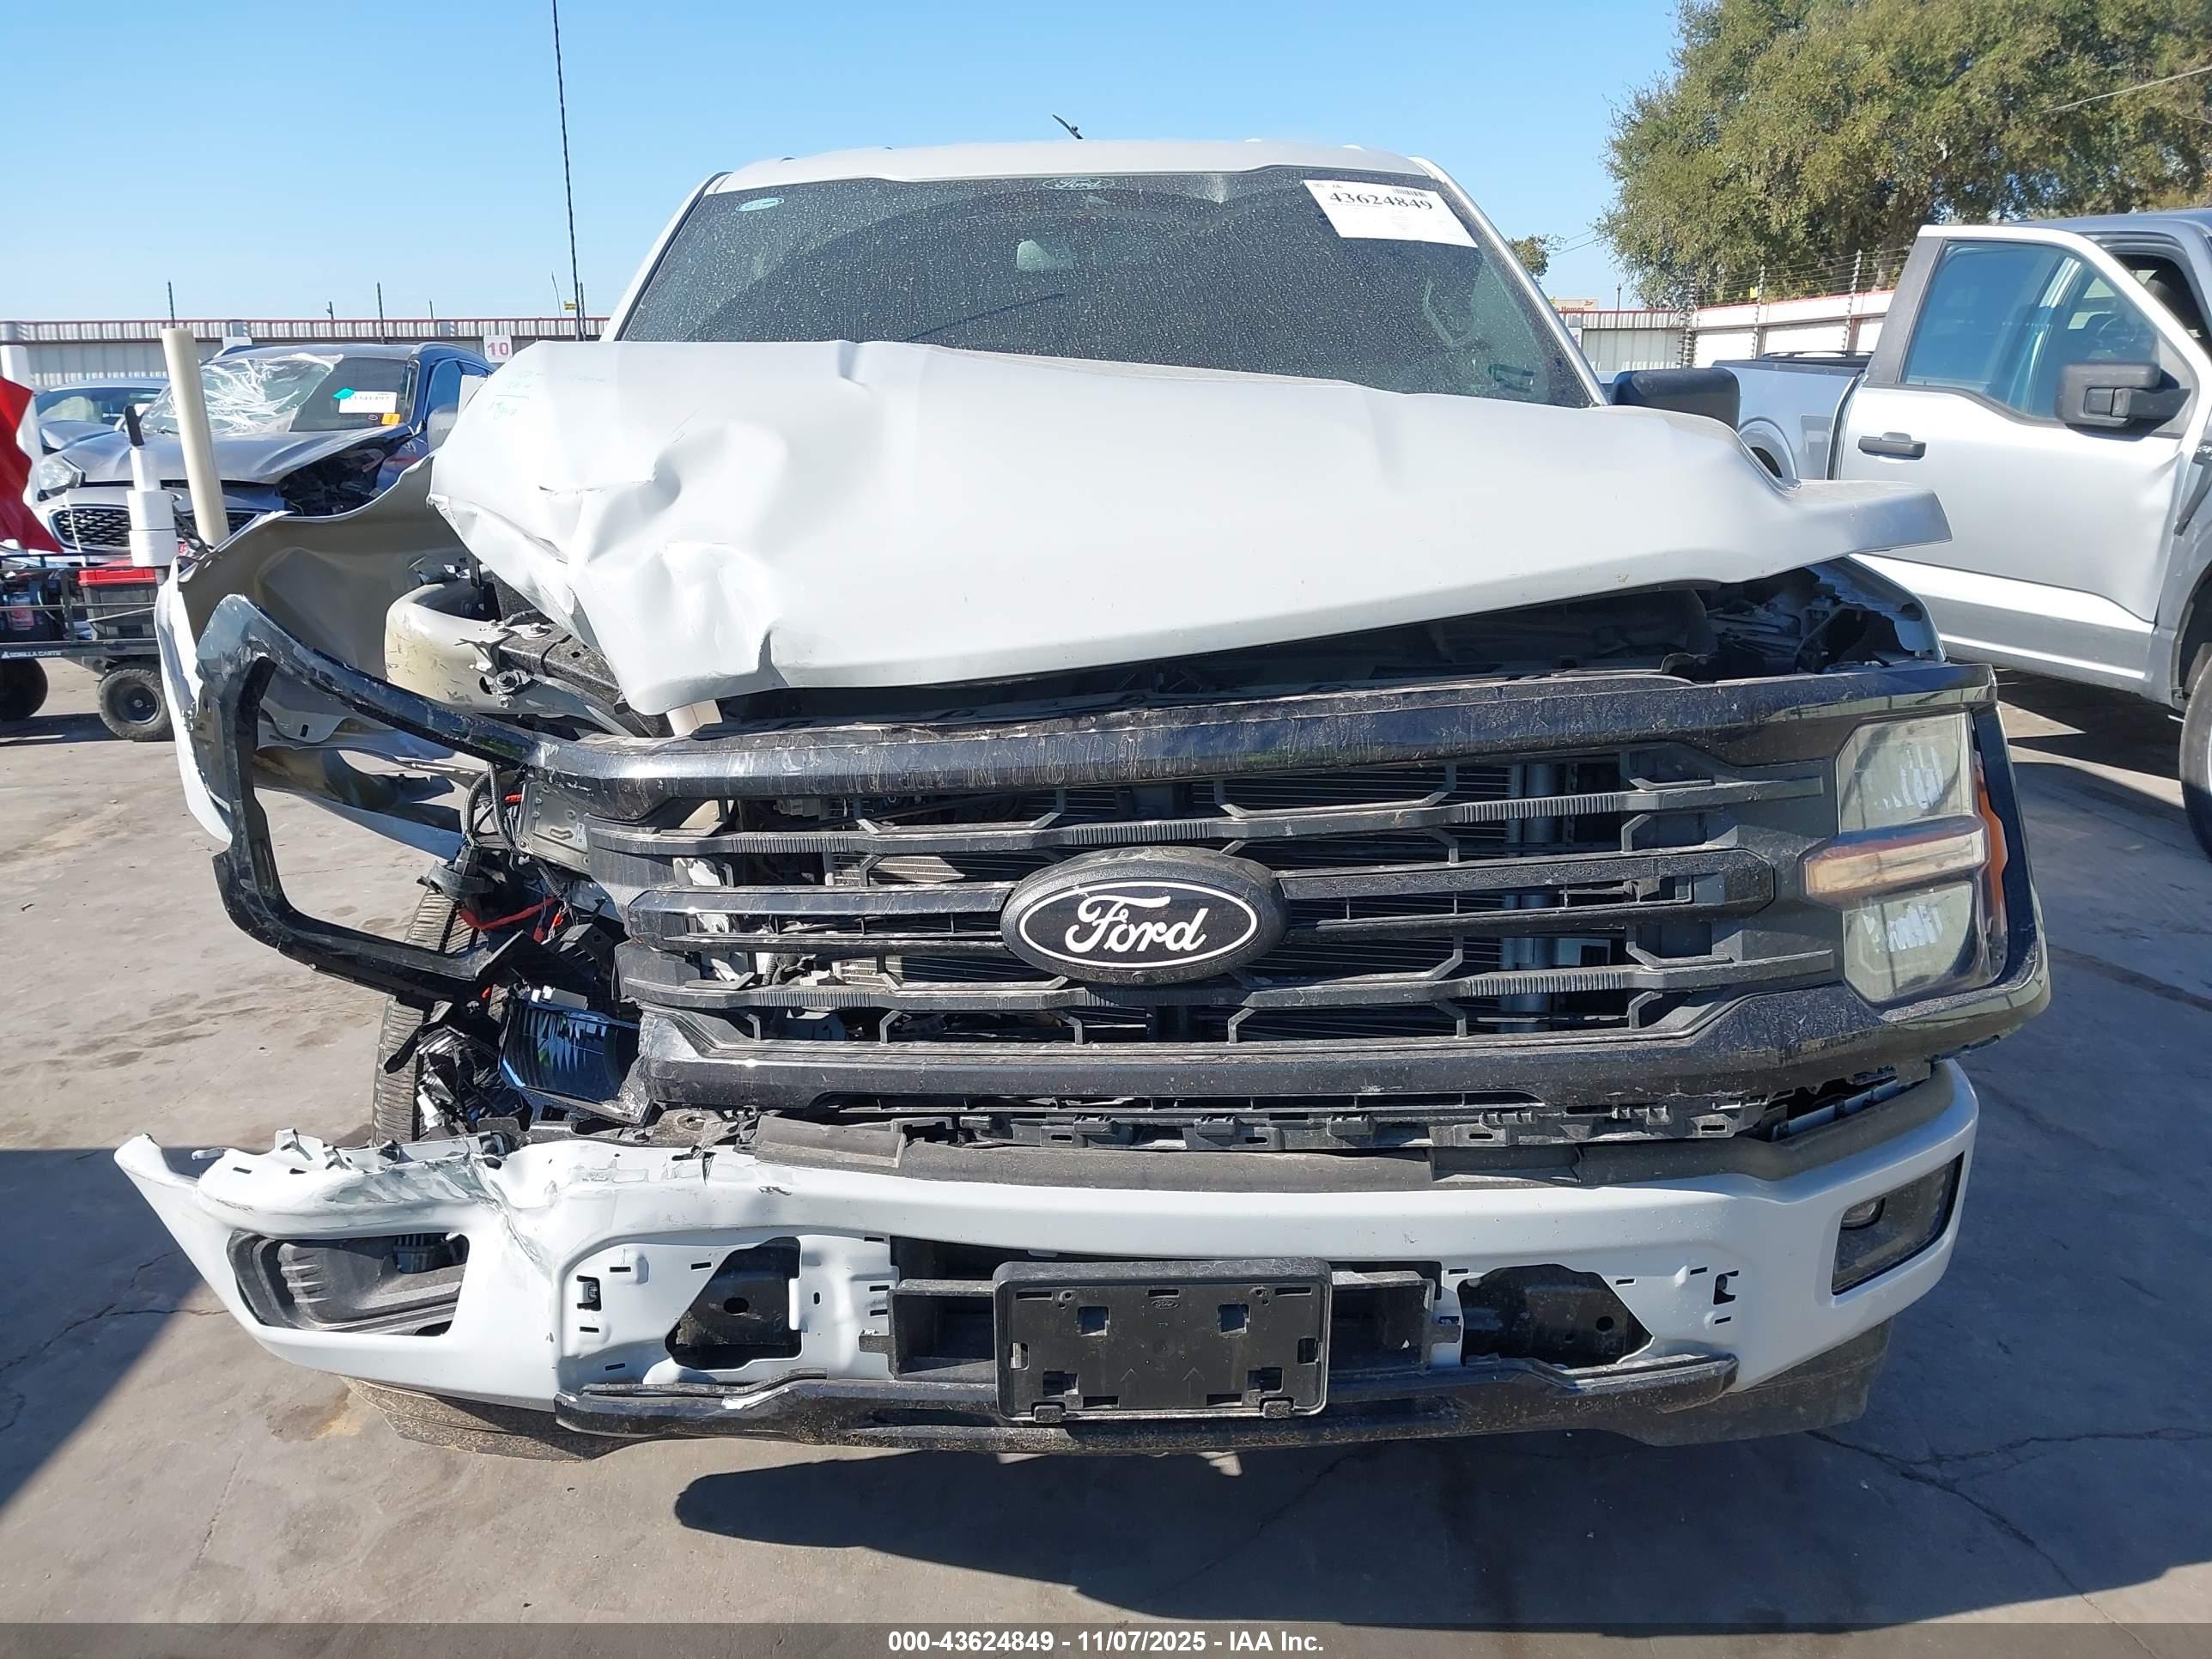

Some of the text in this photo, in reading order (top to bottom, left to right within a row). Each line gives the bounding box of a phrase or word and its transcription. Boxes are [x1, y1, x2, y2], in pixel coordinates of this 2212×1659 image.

[1329, 192, 1433, 210] 43624849
[487, 342, 509, 356] 10
[1065, 895, 1209, 953] Ford
